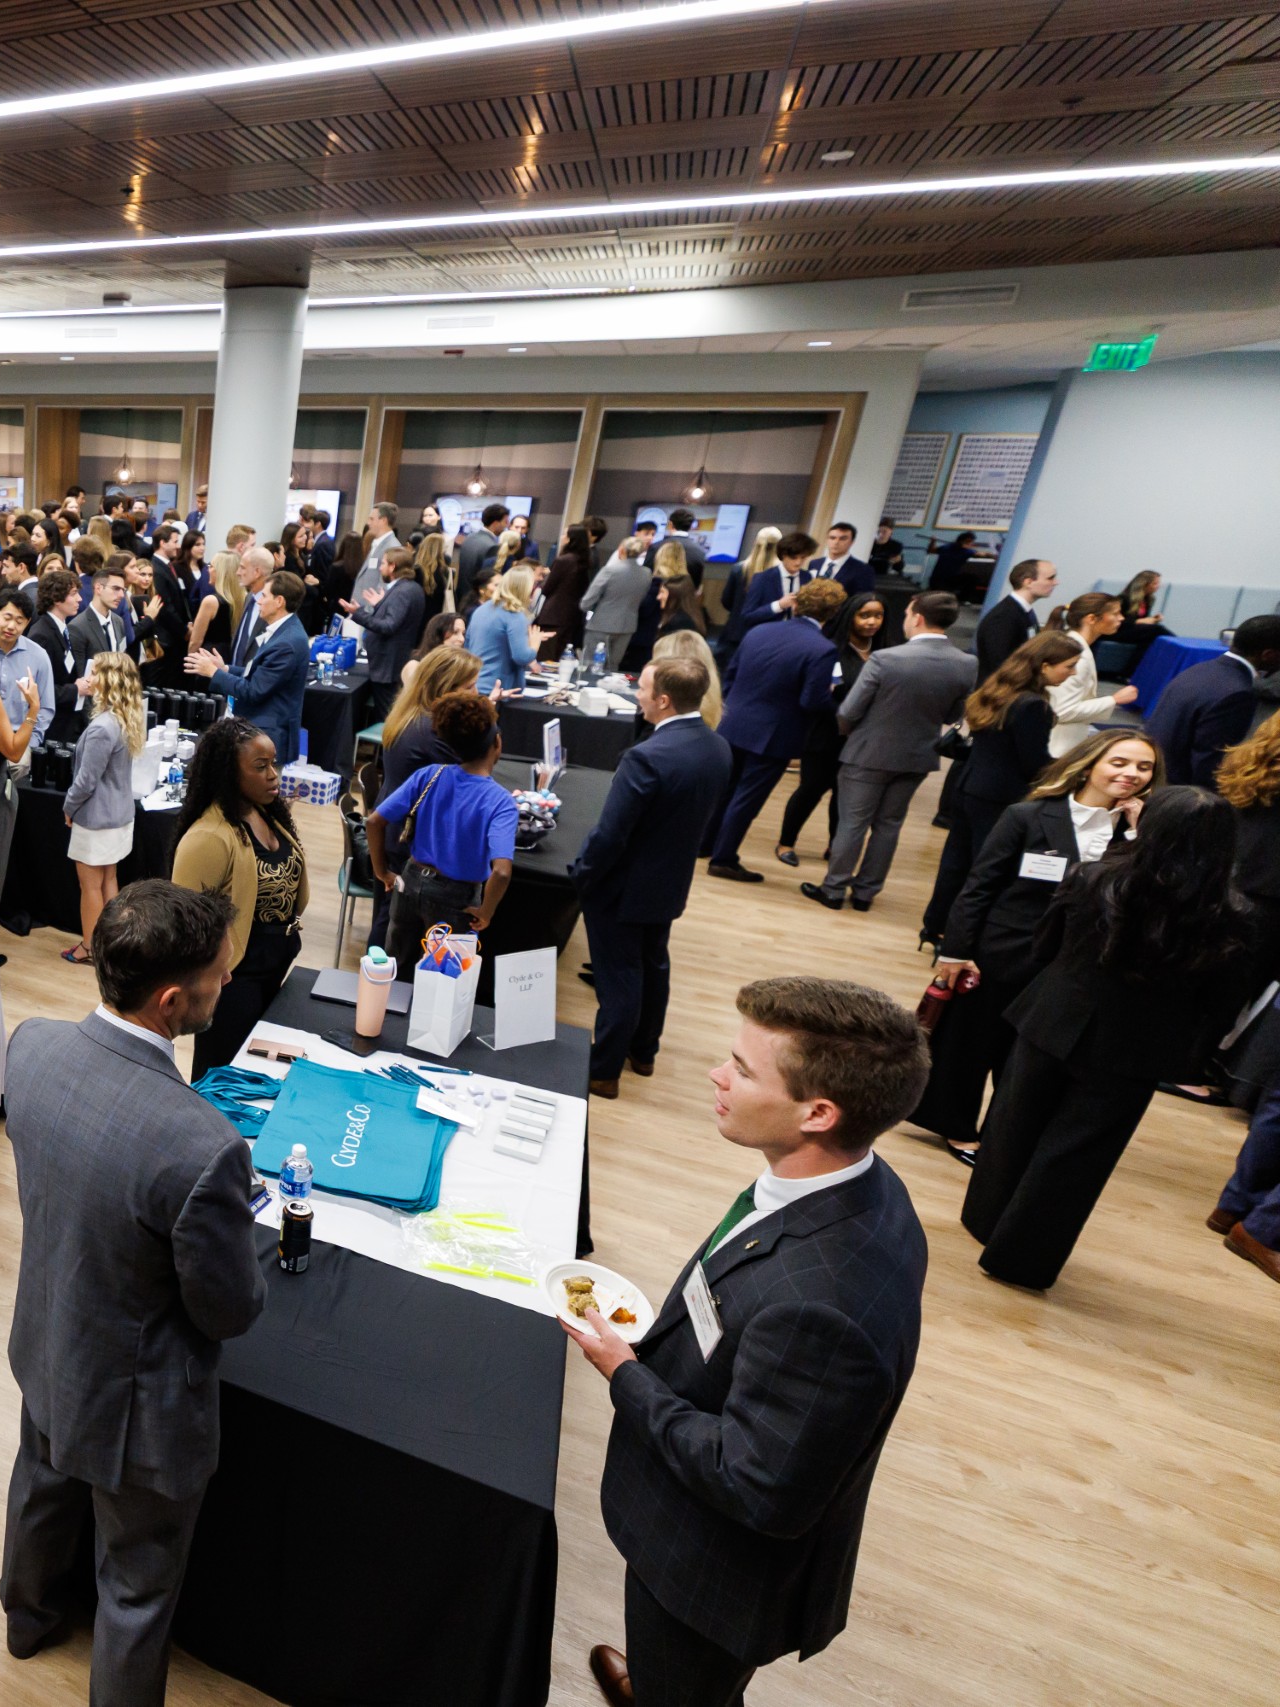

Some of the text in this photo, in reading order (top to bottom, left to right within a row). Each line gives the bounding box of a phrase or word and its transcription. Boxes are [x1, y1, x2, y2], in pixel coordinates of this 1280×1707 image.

[1094, 345, 1138, 369] EXIT
[509, 974, 526, 984] Clyde
[535, 971, 544, 979] Co
[520, 983, 533, 992] LLP
